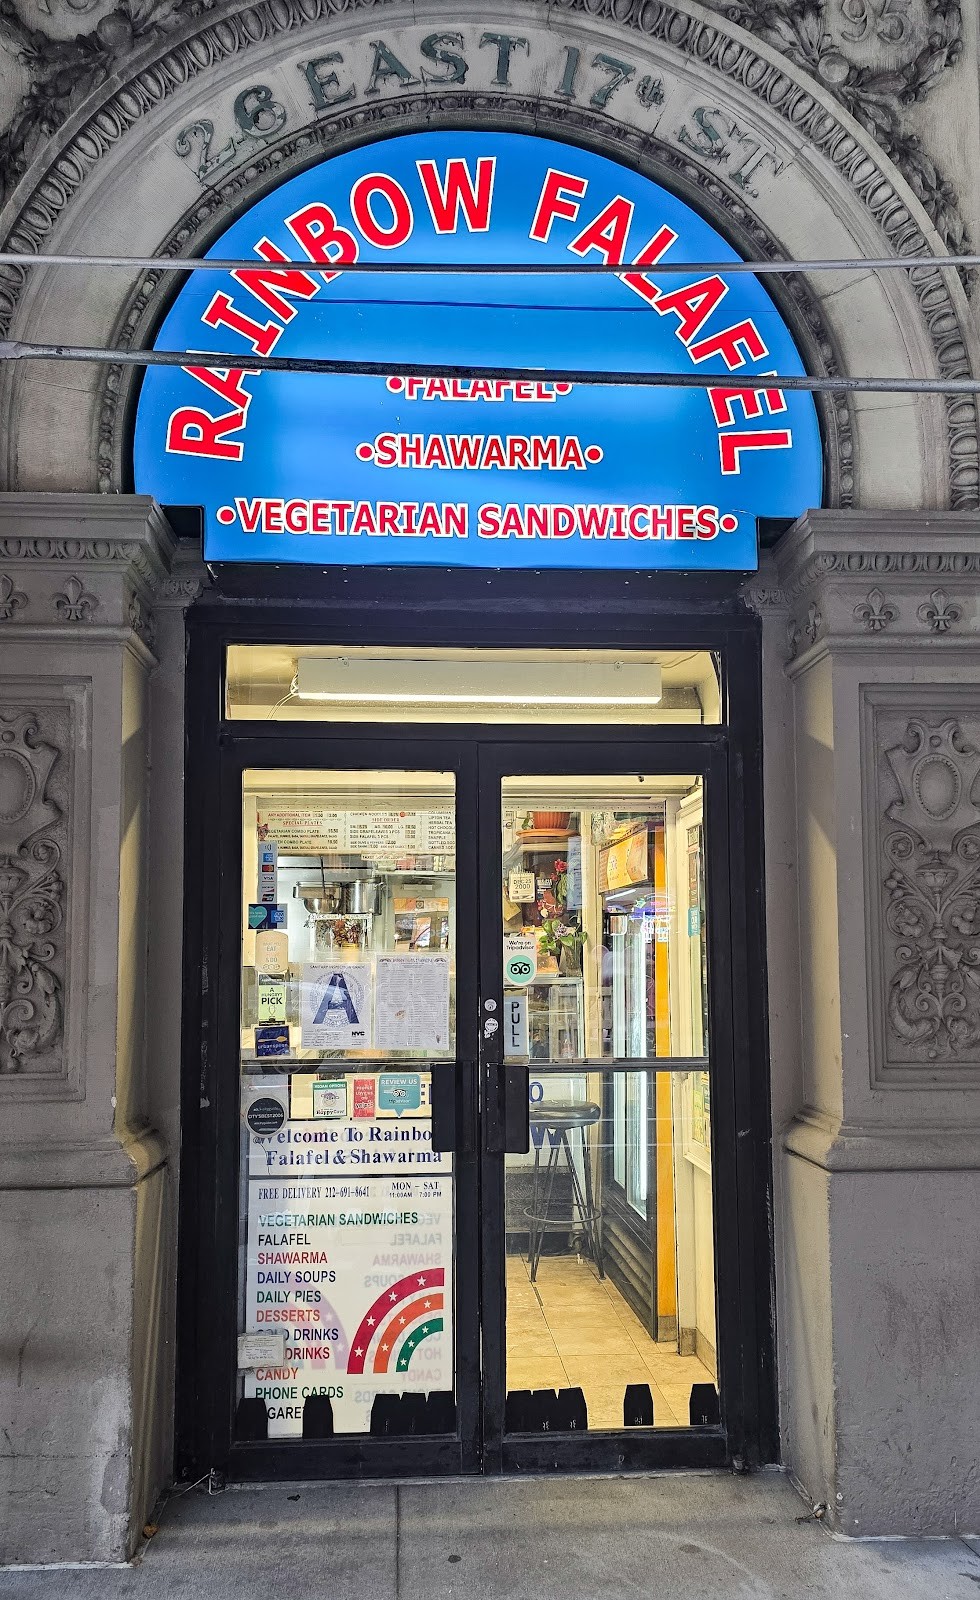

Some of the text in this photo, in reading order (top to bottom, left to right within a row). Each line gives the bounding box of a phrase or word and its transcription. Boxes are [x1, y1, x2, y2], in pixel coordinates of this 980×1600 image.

[174, 84, 288, 177] 26
[297, 31, 531, 113] EAST
[165, 156, 793, 475] RAINBOW FALAFEL
[374, 432, 587, 470] SHAWARMA
[234, 497, 720, 541] VEGETARIAN SANDWICHES
[261, 997, 283, 1005] PICK
[312, 973, 360, 1025] A
[511, 1001, 521, 1048] PULL
[344, 1127, 364, 1143] To
[368, 1126, 432, 1142] Rainbo
[266, 1150, 329, 1166] Falafel
[350, 1148, 442, 1164] Shawarma
[391, 1181, 412, 1190] MON
[423, 1181, 440, 1190] SAT
[258, 1188, 280, 1200] FREE
[282, 1187, 322, 1199] DELIVERY
[259, 1214, 335, 1227] VEGETARIAN
[339, 1212, 418, 1226] SANDWICHES
[258, 1233, 311, 1246] FALAFEL
[257, 1251, 328, 1265] SHAWARMA
[257, 1270, 336, 1284] DAILY SOUPS
[256, 1290, 322, 1304] DAILY PIES
[256, 1309, 321, 1323] DESSERTS
[293, 1328, 339, 1341] DRINKS
[286, 1347, 330, 1360] DRINKS
[256, 1367, 299, 1381] CANDY
[255, 1387, 300, 1400] PHONE
[301, 1386, 344, 1399] CARDS
